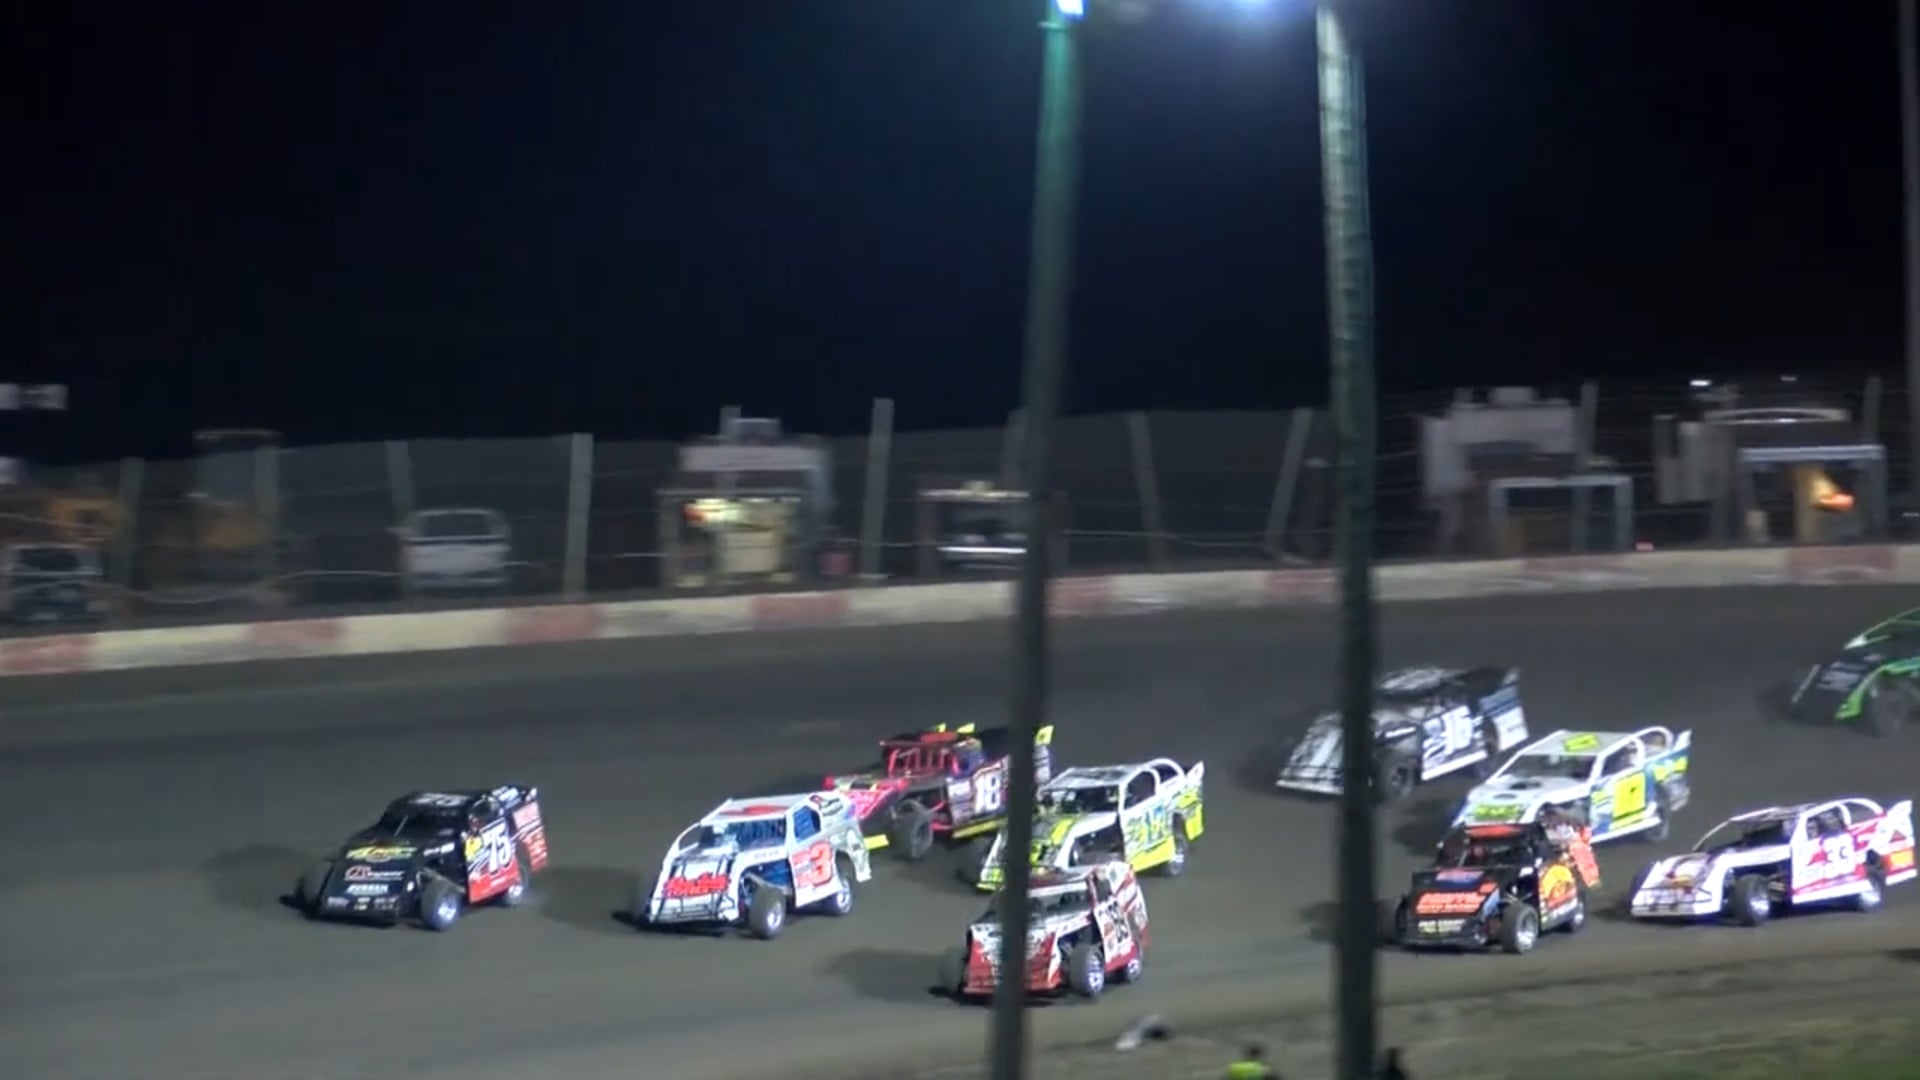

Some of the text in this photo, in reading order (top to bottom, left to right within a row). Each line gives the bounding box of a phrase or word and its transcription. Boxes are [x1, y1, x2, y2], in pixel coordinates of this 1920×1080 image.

[974, 769, 1001, 815] 18
[481, 823, 512, 874] 75
[1823, 836, 1860, 878] 33
